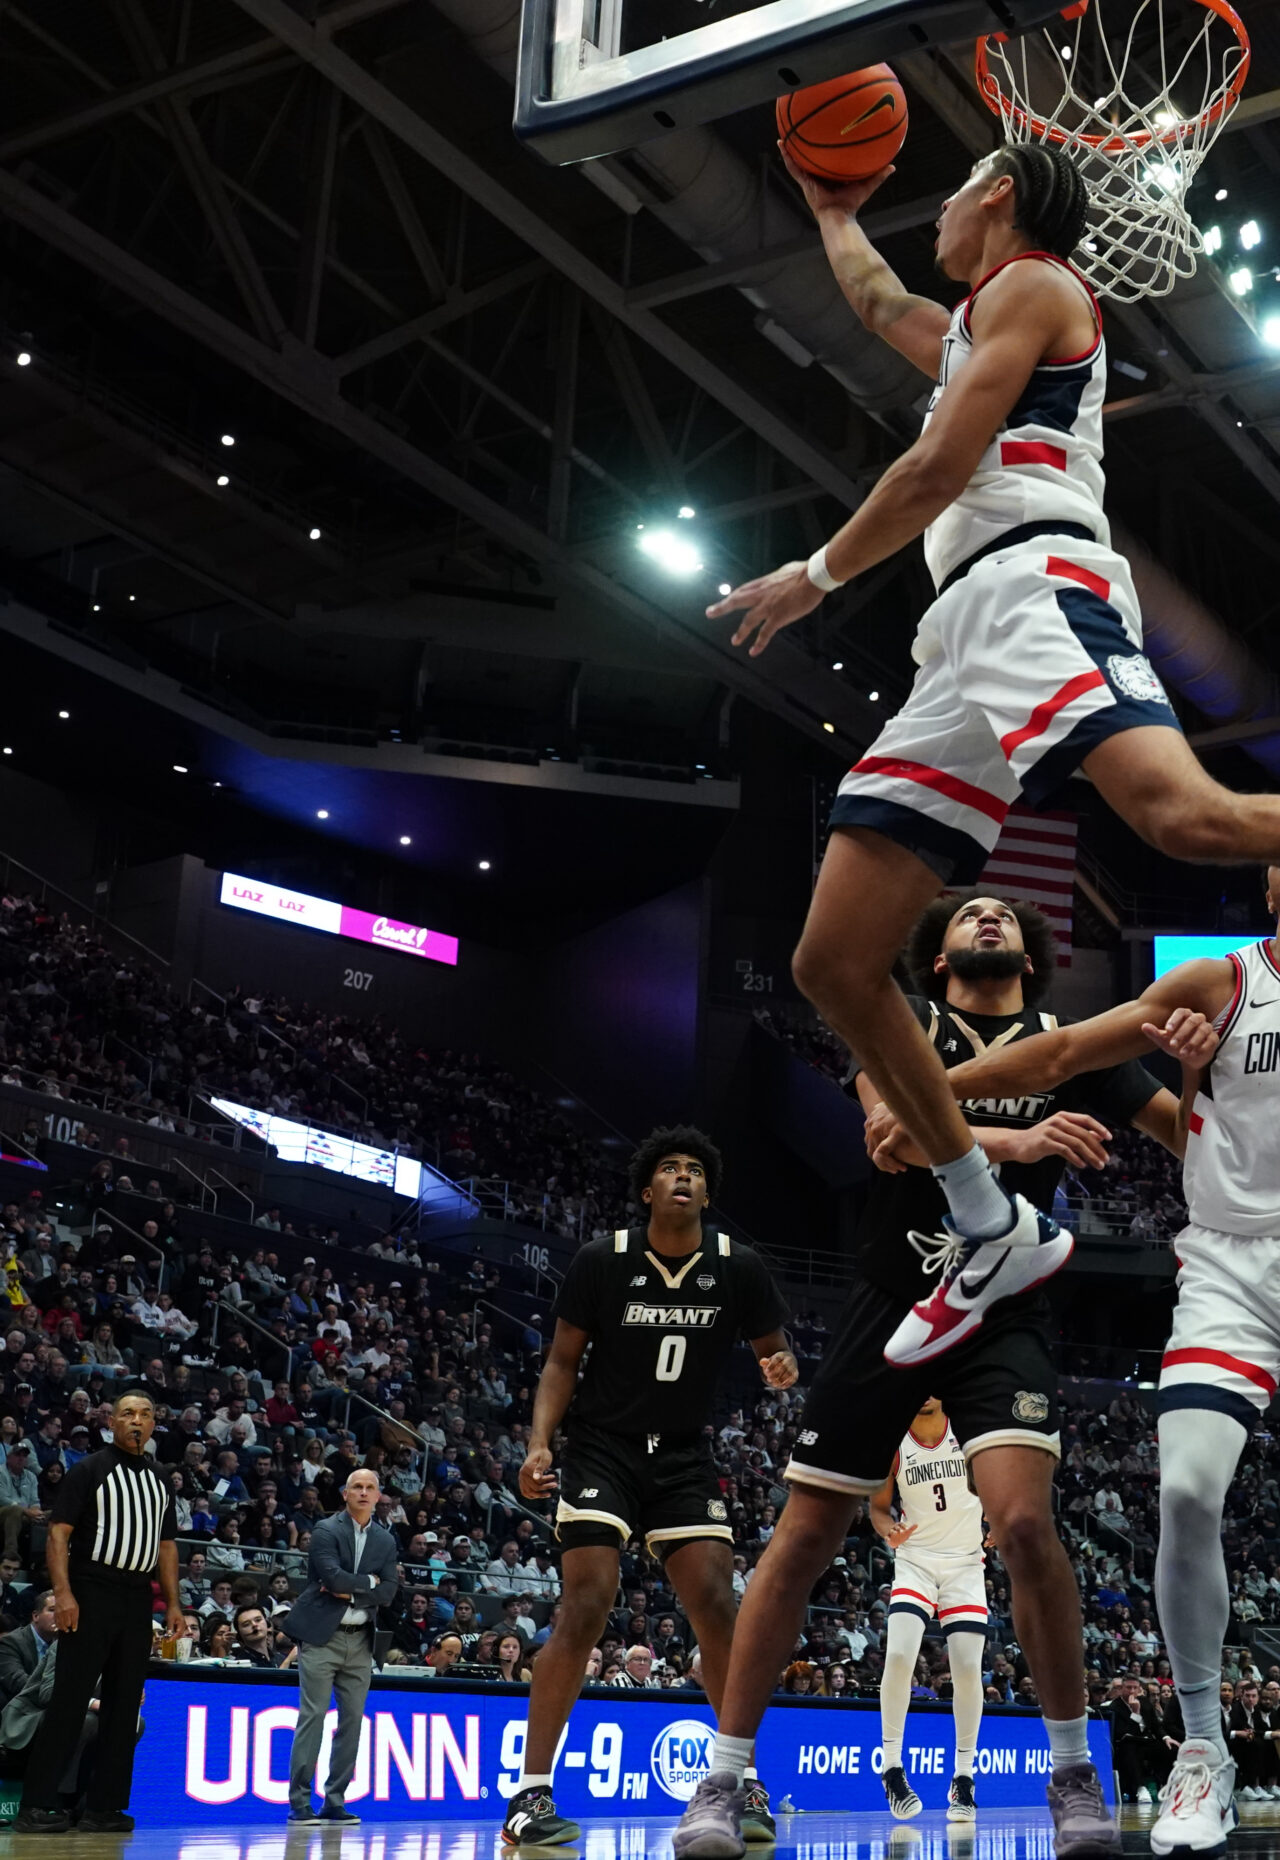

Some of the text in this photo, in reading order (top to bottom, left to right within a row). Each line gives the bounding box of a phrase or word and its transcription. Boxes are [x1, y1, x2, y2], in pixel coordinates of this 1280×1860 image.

[343, 968, 374, 991] 207
[743, 973, 774, 993] 231
[522, 1243, 550, 1272] 106
[625, 1304, 716, 1325] BRYANT
[655, 1335, 687, 1382] 0
[905, 1458, 967, 1486] CONNECTICUT
[932, 1483, 947, 1512] 3
[185, 1705, 480, 1805] UCONN
[668, 1737, 710, 1770] FOX
[798, 1745, 861, 1775] HOME
[871, 1746, 885, 1774] O
[908, 1747, 945, 1773] THE
[622, 1772, 649, 1800] FM
